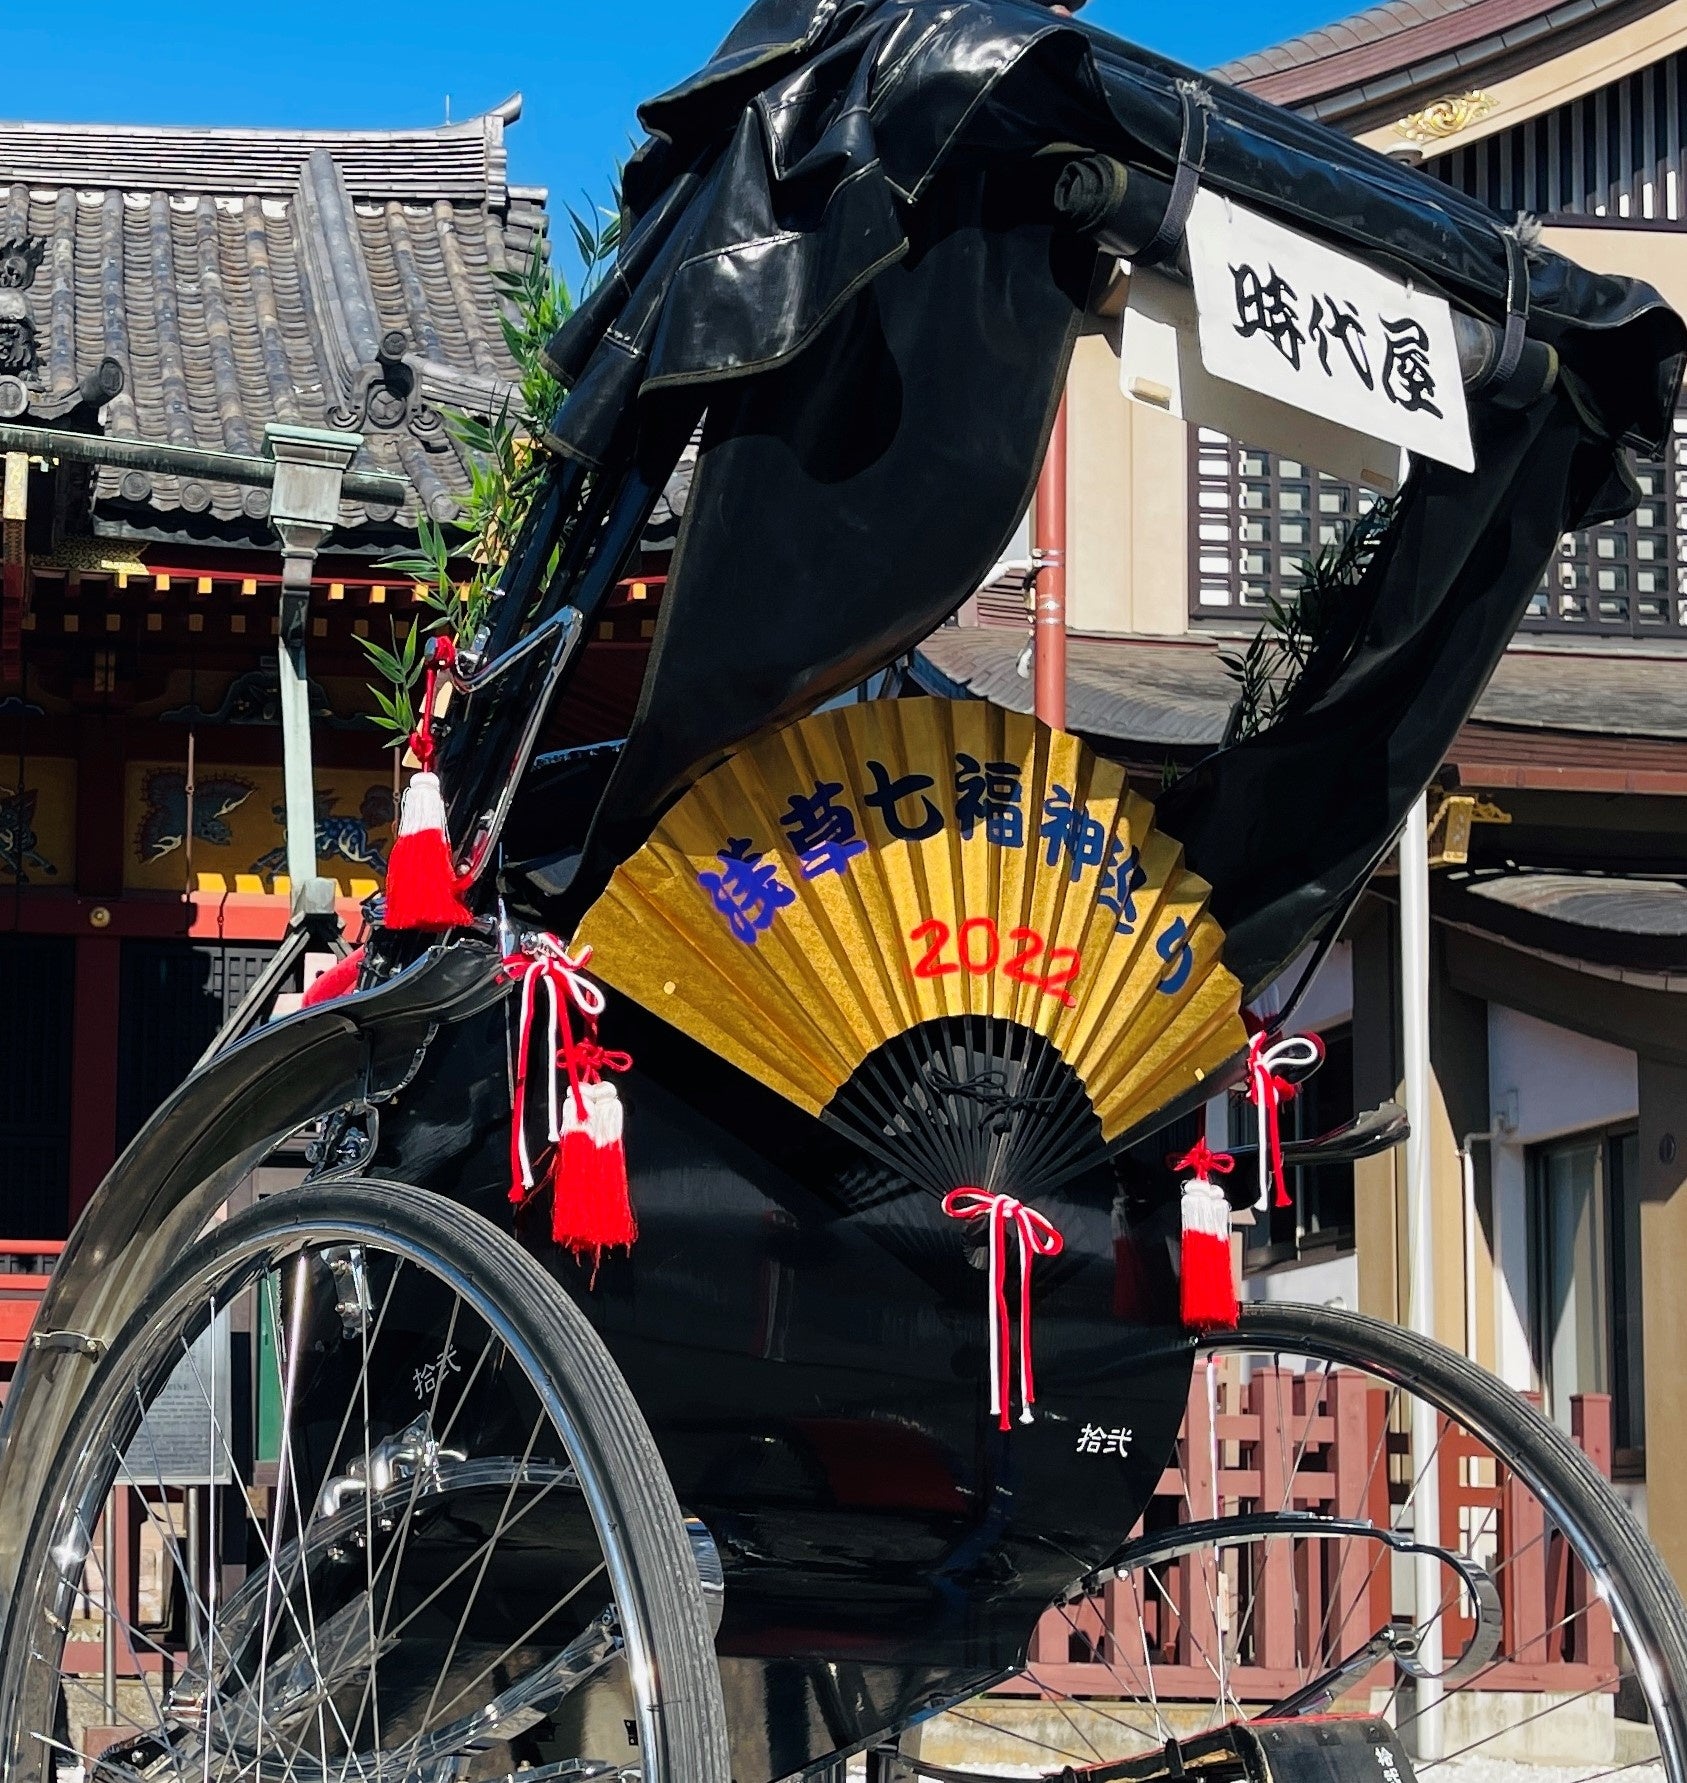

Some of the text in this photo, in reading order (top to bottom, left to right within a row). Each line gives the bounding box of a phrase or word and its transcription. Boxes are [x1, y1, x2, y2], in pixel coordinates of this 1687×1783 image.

[1227, 261, 1444, 420] 時代屋
[909, 916, 1082, 1008] 2022
[1075, 1422, 1133, 1458] 拾弐
